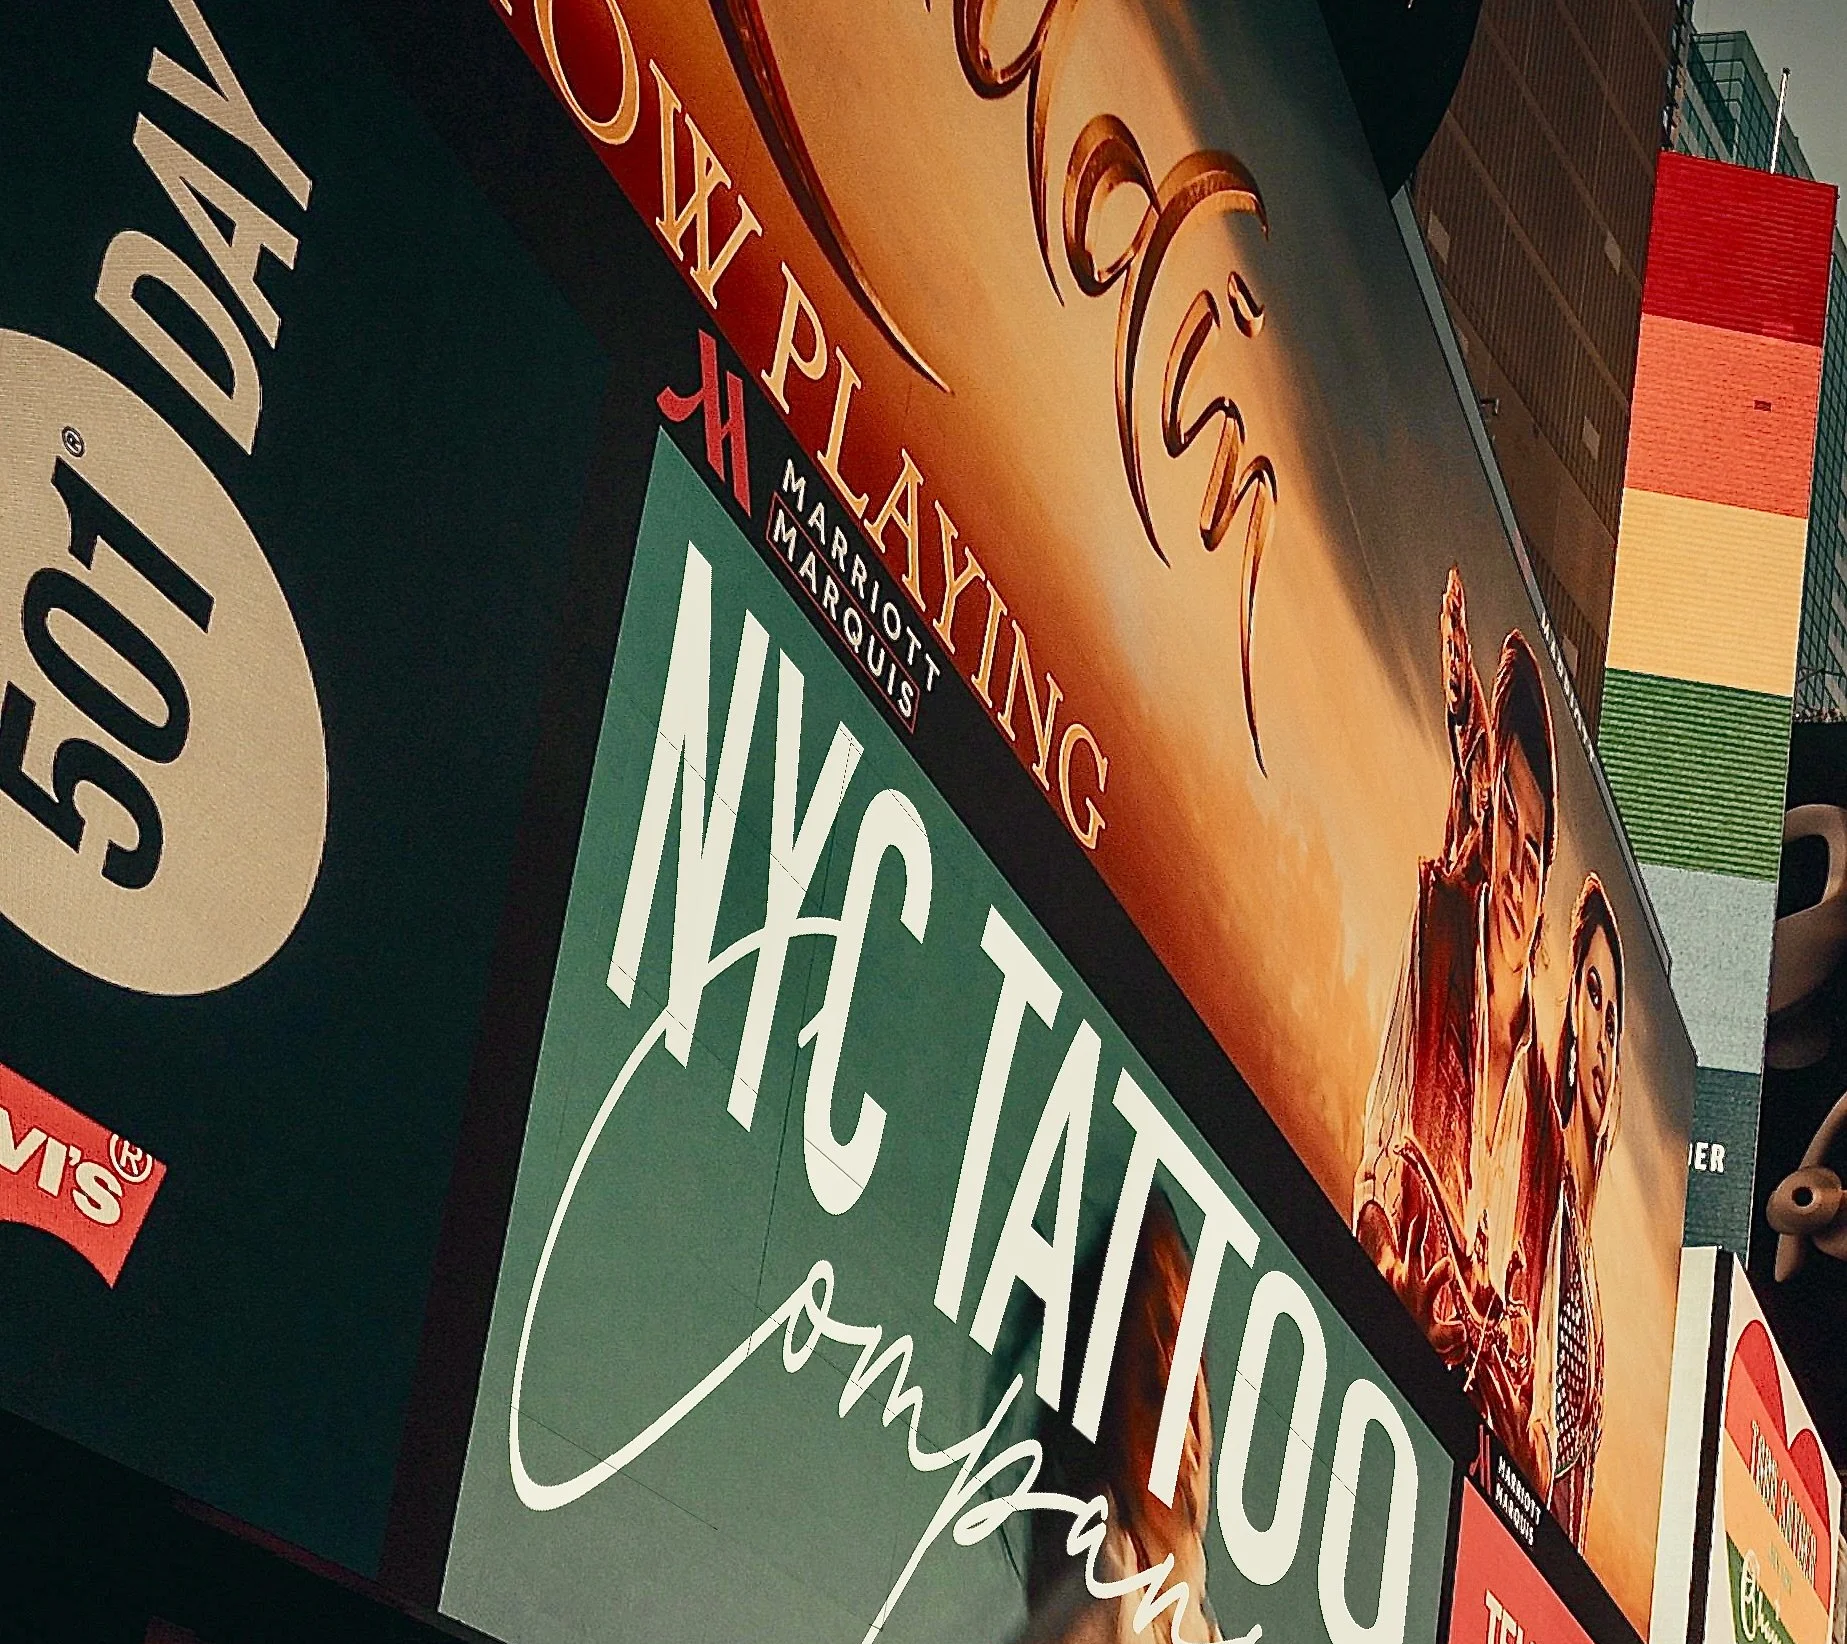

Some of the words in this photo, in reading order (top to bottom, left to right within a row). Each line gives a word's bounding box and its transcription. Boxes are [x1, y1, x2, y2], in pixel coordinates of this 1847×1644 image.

[96, 0, 312, 455] DAY
[760, 261, 1109, 850] PLAYING
[773, 509, 914, 718] MARQUIS
[782, 457, 942, 692] MARRIOTT
[606, 539, 933, 1216] NYC
[1495, 1482, 1534, 1546] MARQUIS
[1498, 1455, 1541, 1526] MARRIOTT
